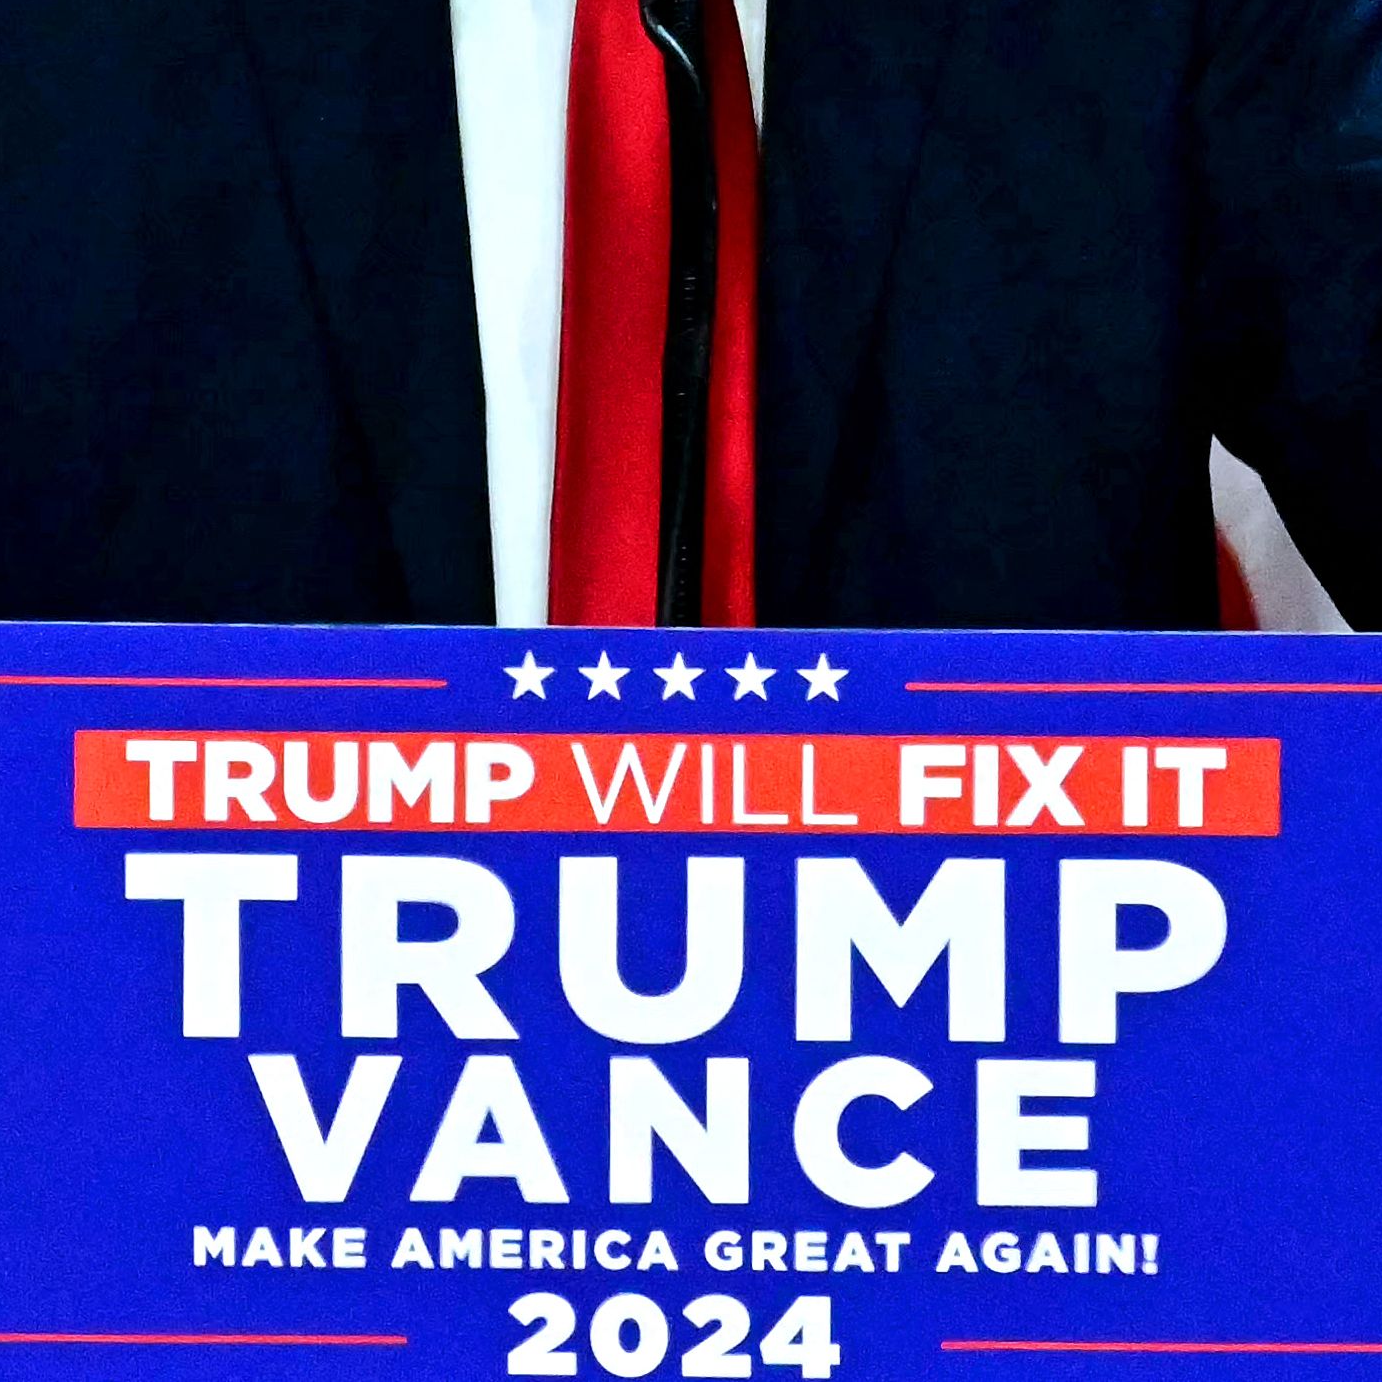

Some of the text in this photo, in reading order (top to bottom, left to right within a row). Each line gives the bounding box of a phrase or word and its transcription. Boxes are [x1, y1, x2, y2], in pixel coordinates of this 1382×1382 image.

[125, 739, 1228, 828] TRUMP WILL FIX IT
[124, 852, 1228, 1045] TRUMP
[247, 1053, 1098, 1209] VANCE
[193, 1225, 1158, 1275] MAKE AMERICA GREAT AGAIN!
[507, 1292, 841, 1379] 2024
